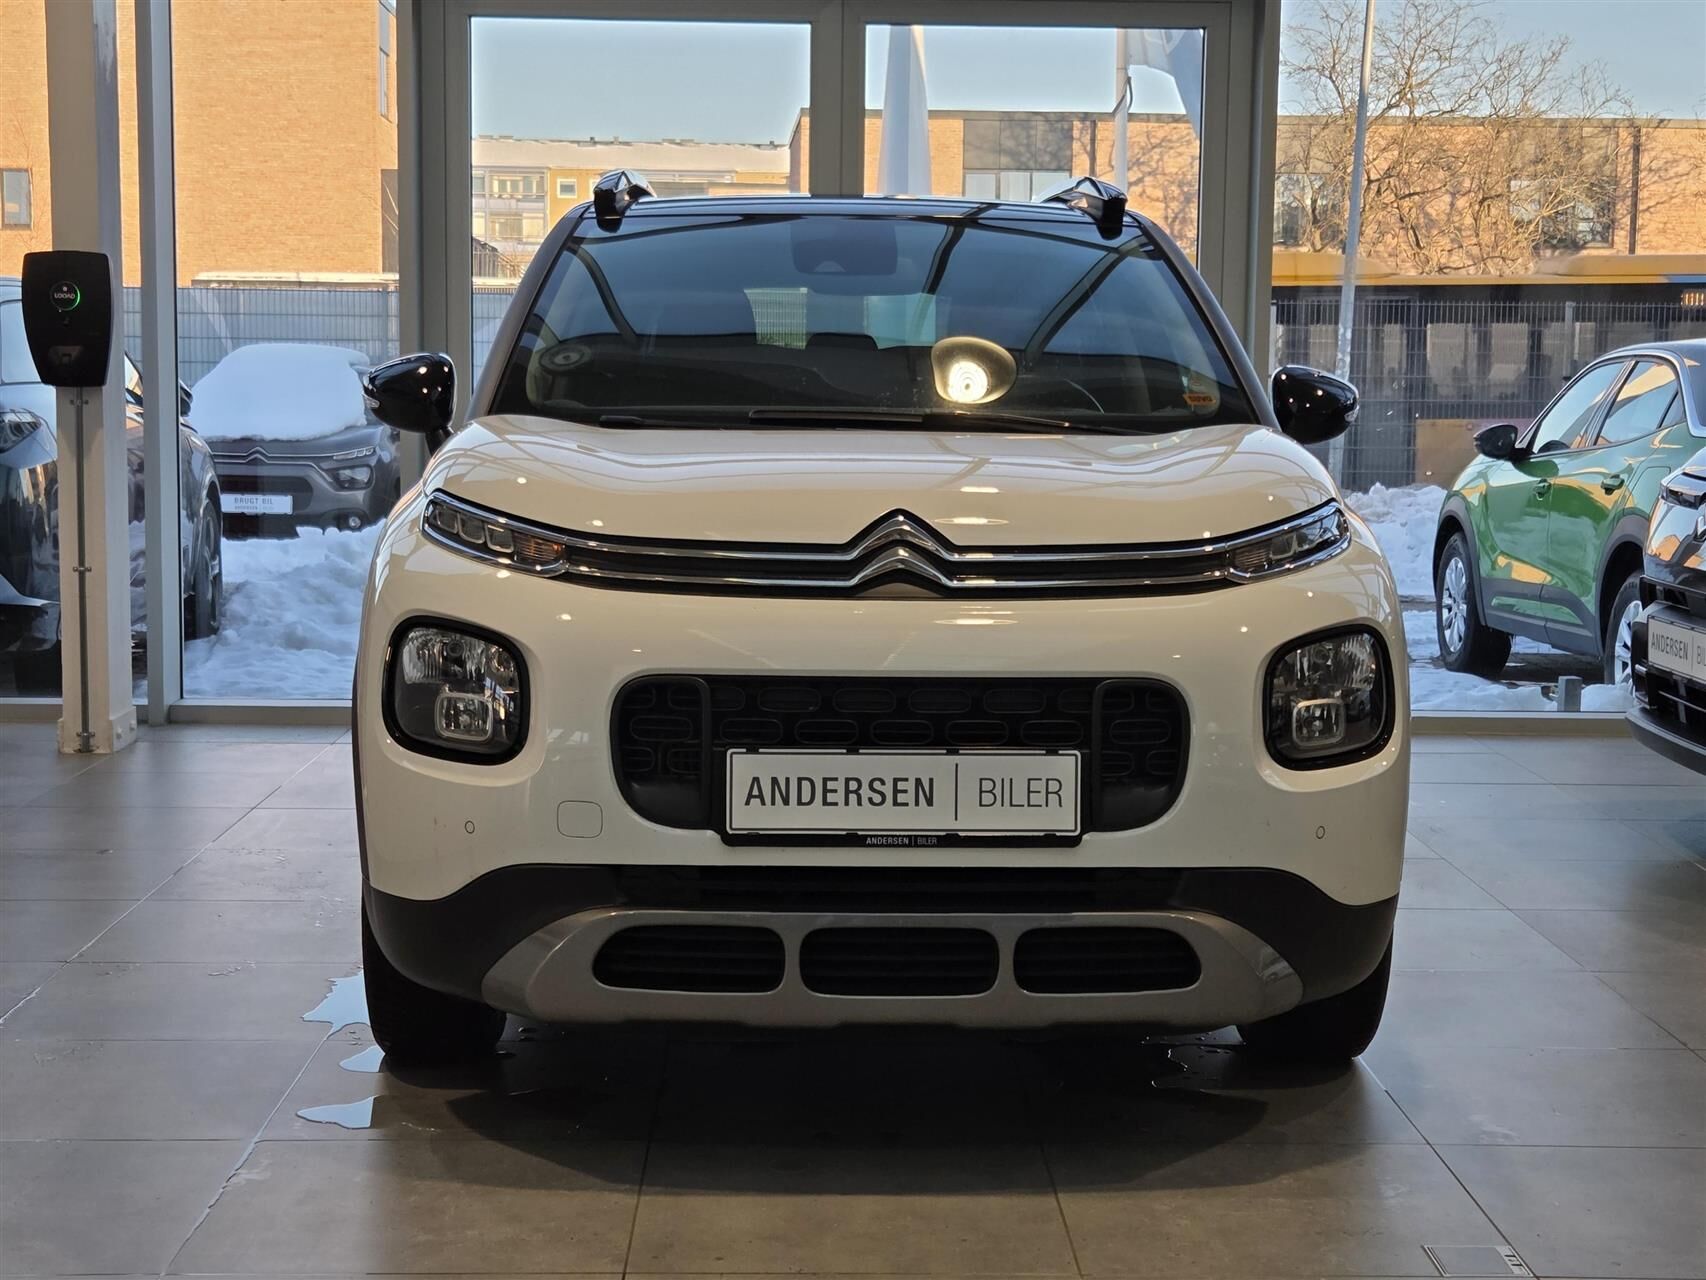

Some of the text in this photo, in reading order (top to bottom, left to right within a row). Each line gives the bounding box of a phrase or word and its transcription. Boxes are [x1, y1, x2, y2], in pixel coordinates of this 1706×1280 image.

[1651, 632, 1688, 660] ANDERSEN
[744, 776, 1063, 808] ANDERSEN BILER
[866, 836, 937, 845] ANDERSEN BILER
